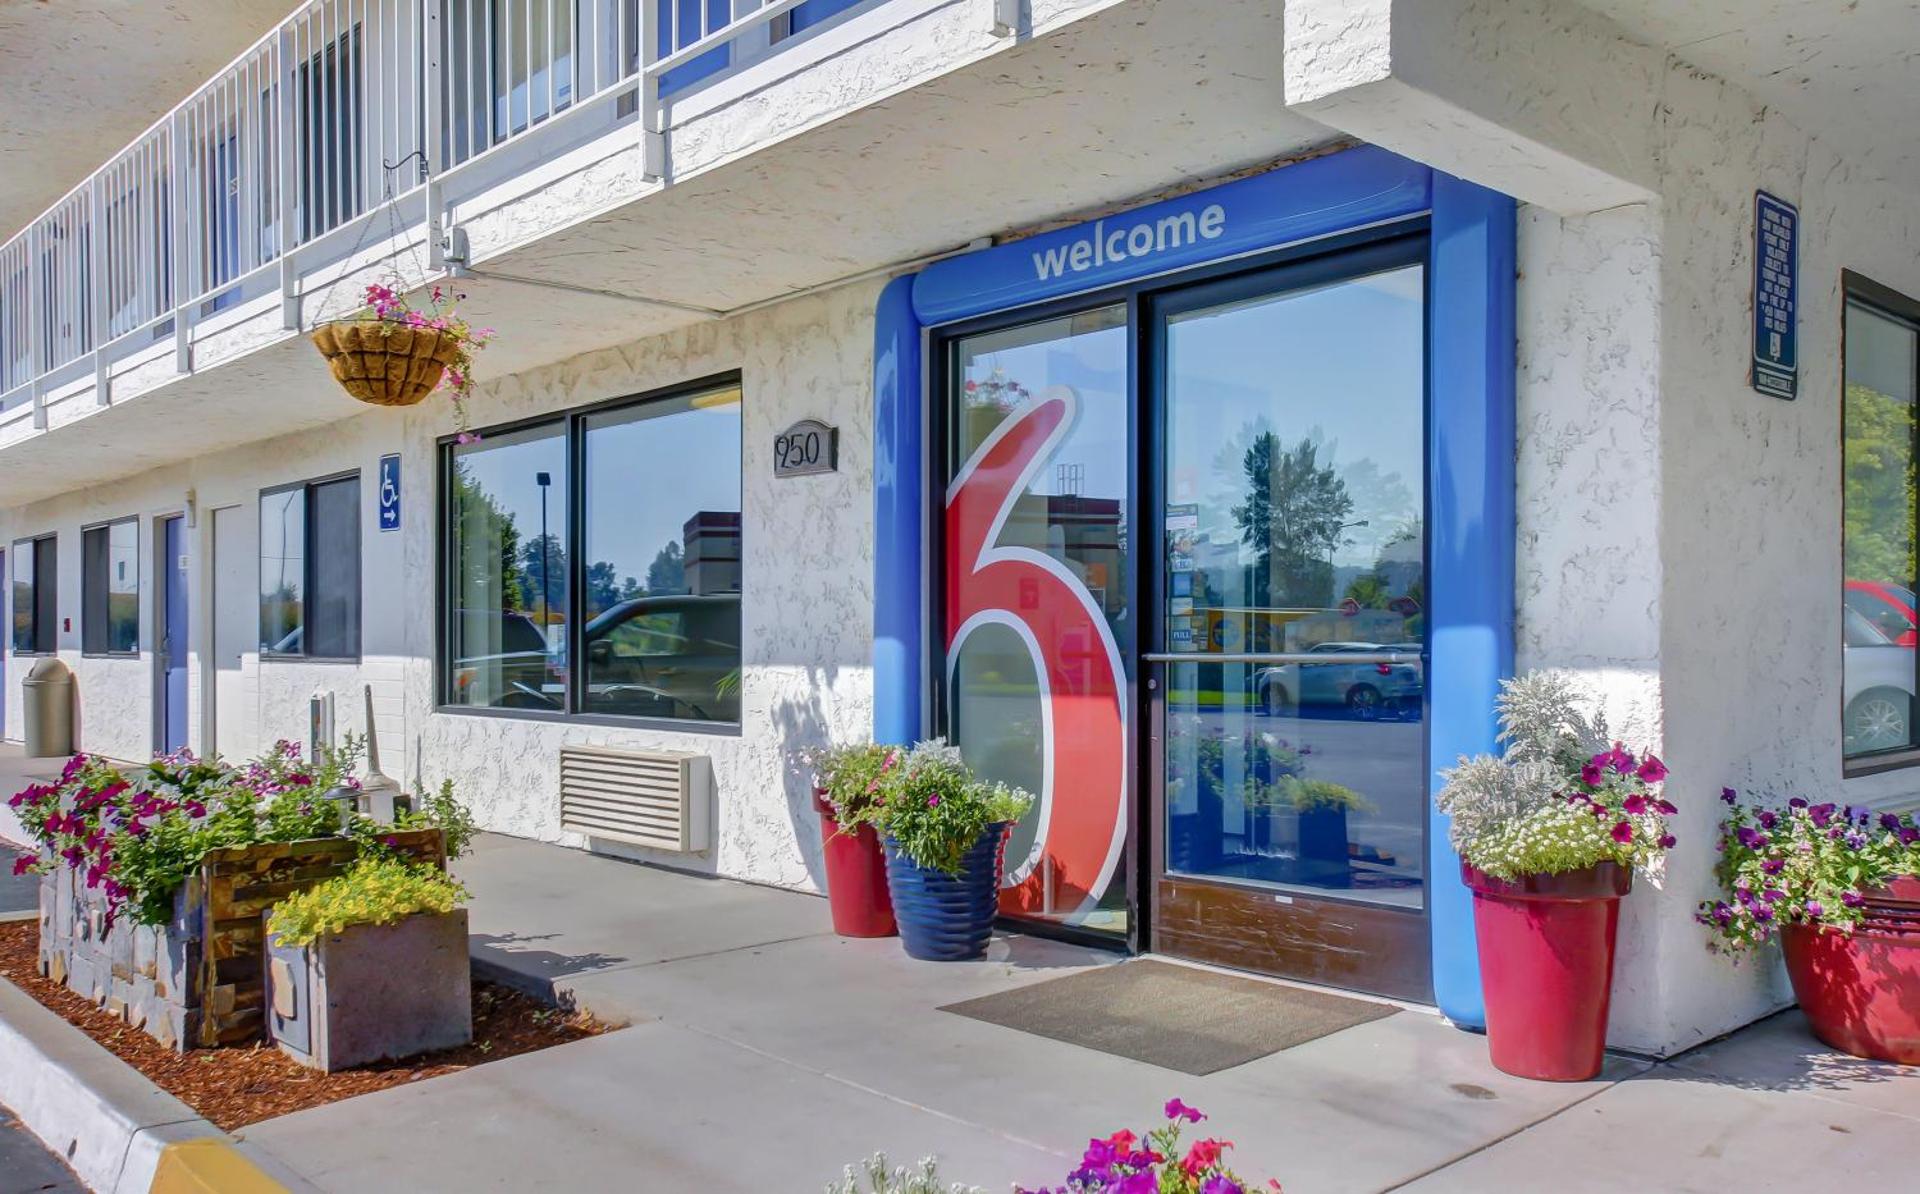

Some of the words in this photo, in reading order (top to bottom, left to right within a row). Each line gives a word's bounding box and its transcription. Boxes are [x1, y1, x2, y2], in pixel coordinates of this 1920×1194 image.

[1032, 204, 1226, 281] welcome
[776, 431, 820, 469] 950
[946, 384, 1128, 926] 6
[1173, 631, 1190, 640] PULL
